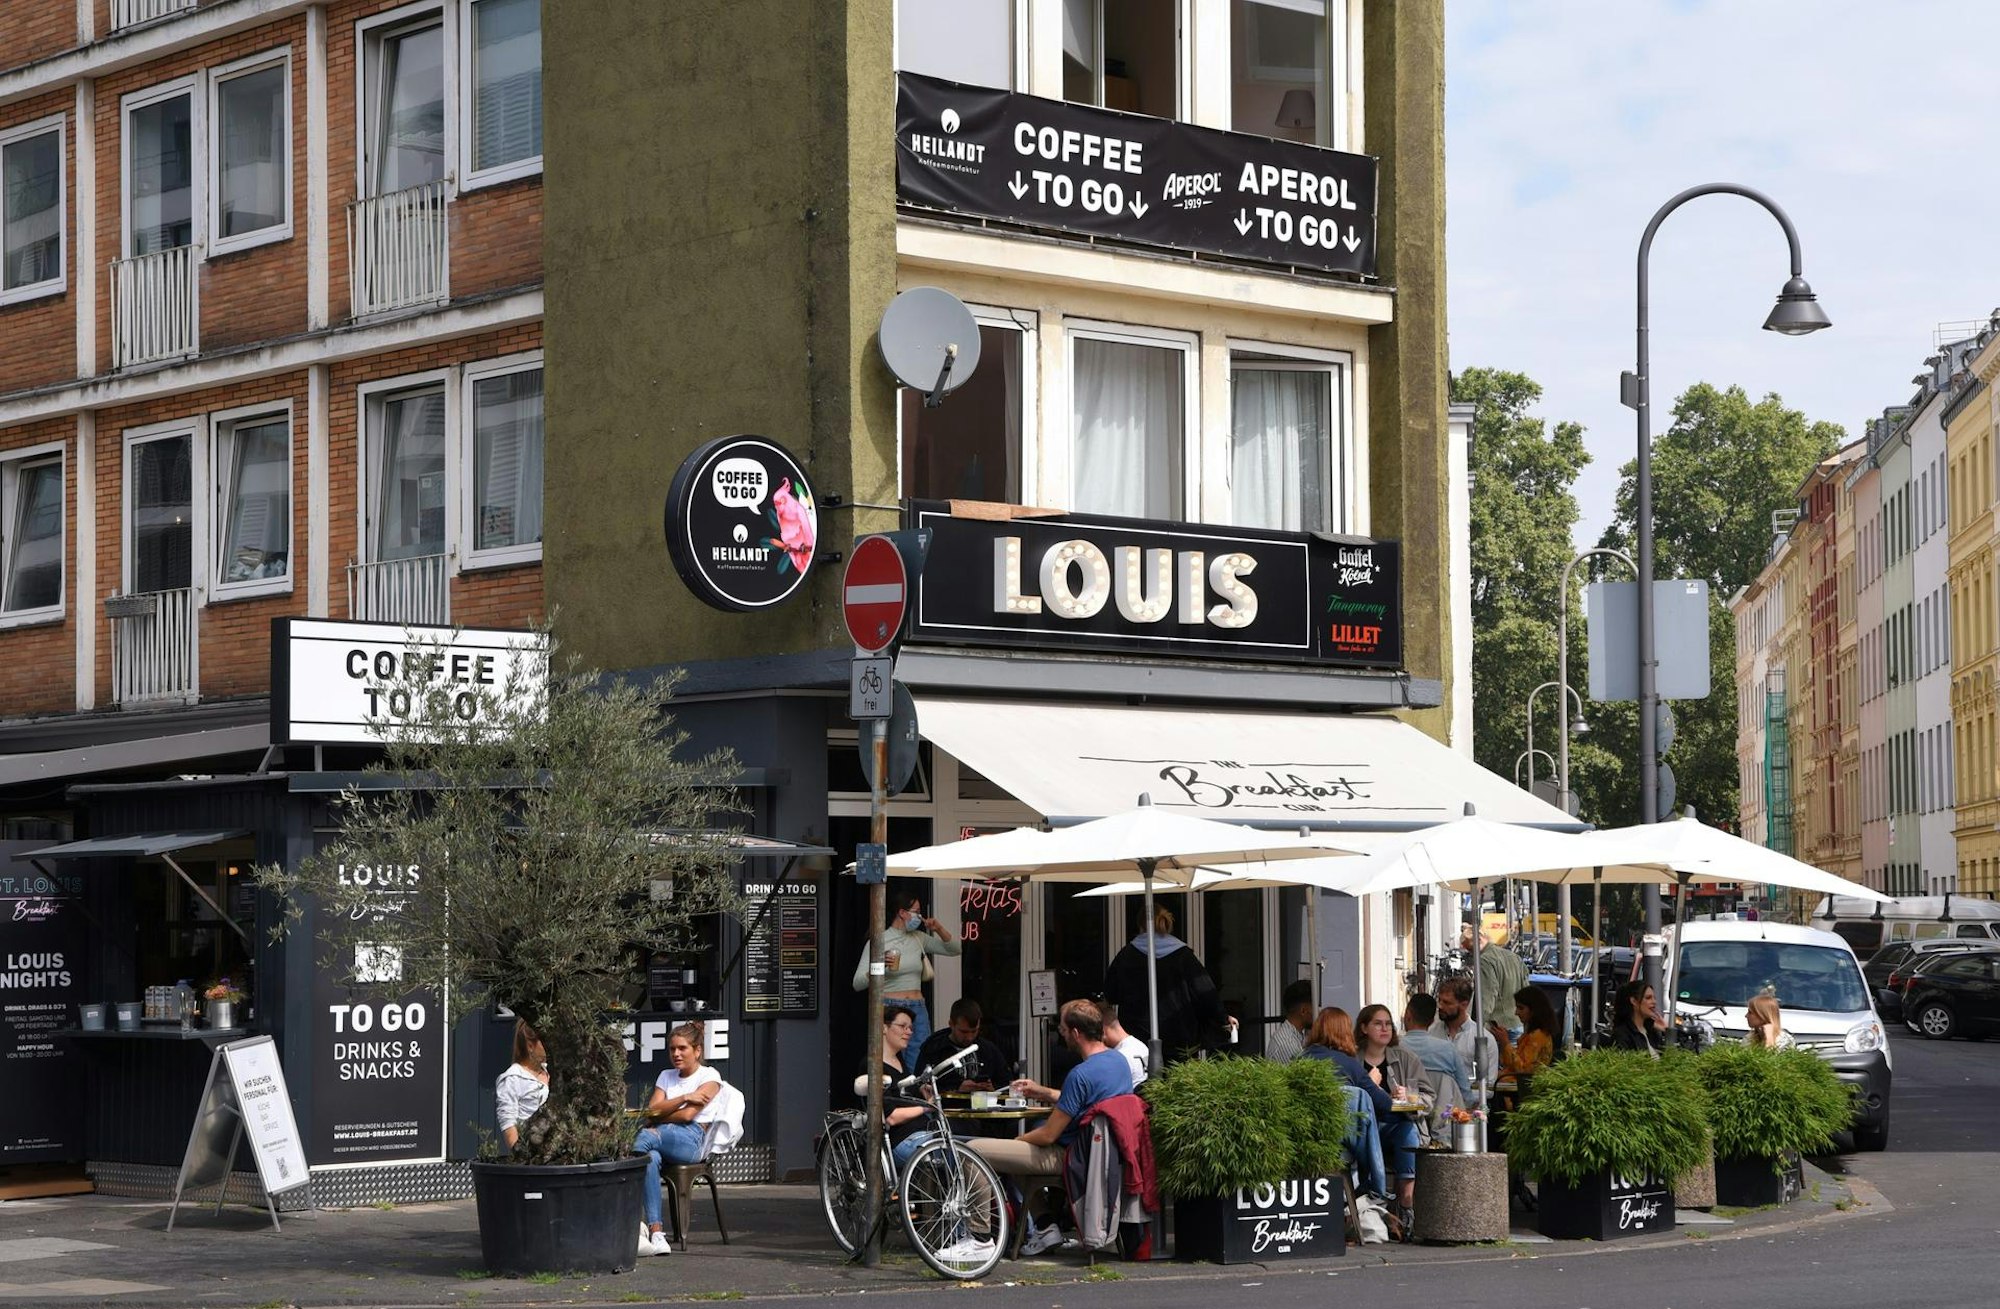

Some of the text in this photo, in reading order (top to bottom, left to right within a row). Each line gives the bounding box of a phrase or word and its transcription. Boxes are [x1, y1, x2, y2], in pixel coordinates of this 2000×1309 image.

[911, 133, 986, 164] HEILANDT
[1014, 121, 1143, 175] COFFEE
[918, 157, 980, 175] Kaffeemanufaktur
[1032, 169, 1124, 216] TO GO
[1162, 172, 1222, 201] APEROL
[1238, 162, 1357, 211] APEROL
[1183, 199, 1202, 210] 1919
[1255, 207, 1339, 250] TO GO
[717, 470, 763, 486] COFFEE
[722, 485, 758, 500] TO GO
[712, 546, 770, 562] HEILANDT
[1338, 546, 1374, 568] Gaffel
[994, 536, 1259, 629] LOUIS
[1338, 567, 1374, 587] Kölsch
[1331, 623, 1382, 645] LILLET
[345, 649, 495, 685] COFFEE
[363, 687, 412, 719] TO
[863, 697, 878, 711] frei
[1158, 765, 1375, 808] Breakfast
[338, 864, 420, 886] LOUIS
[786, 884, 800, 894] TO
[802, 884, 817, 894] GO
[12, 900, 64, 922] Breakfast
[8, 952, 65, 970] LOUIS
[0, 970, 72, 989] NIGHTS
[329, 1002, 426, 1033] TO GO
[333, 1040, 421, 1060] DRINKS &
[339, 1061, 415, 1081] SNACKS
[333, 1128, 419, 1140] WWW.LOUIS-BREAKFAST.DE
[1236, 1178, 1331, 1210] LOUIS
[1619, 1199, 1663, 1230] Breakfast
[1251, 1219, 1323, 1253] Breakfast
